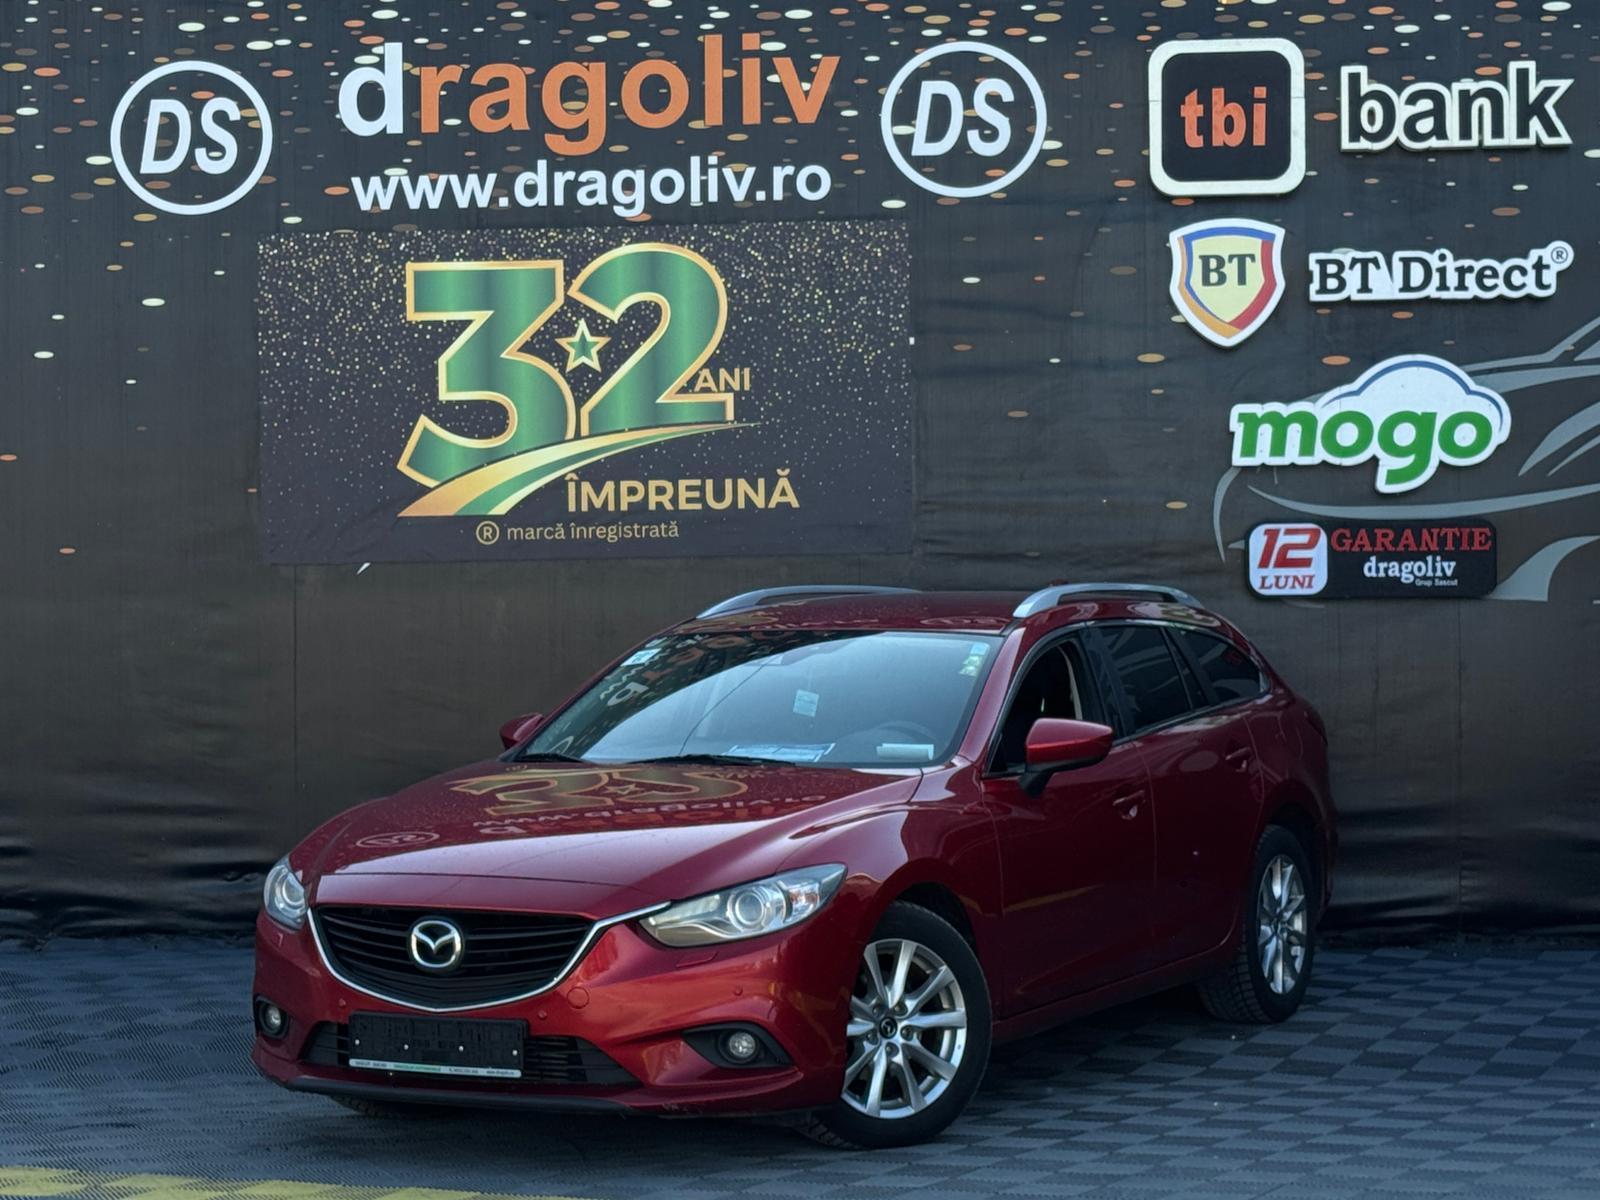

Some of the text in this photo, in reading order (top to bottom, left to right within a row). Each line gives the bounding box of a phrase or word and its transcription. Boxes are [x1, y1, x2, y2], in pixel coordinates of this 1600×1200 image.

[338, 33, 841, 157] dragoliv
[1180, 61, 1574, 151] tbi bank
[139, 97, 242, 175] DS
[911, 78, 1015, 157] DS
[350, 155, 832, 218] www.dragoliv.ro
[1199, 253, 1256, 287] BT
[1315, 258, 1382, 295] BT
[396, 242, 751, 488] 32 ANI
[1236, 410, 1493, 485] mogo
[564, 468, 800, 512] ÎMPREUNĂ
[506, 522, 566, 541] marcă
[569, 520, 679, 543] înregistrată
[1257, 527, 1321, 569] 12
[1330, 527, 1493, 552] GARANTIE
[1259, 575, 1315, 590] LUNI
[1363, 555, 1457, 584] dragoliv
